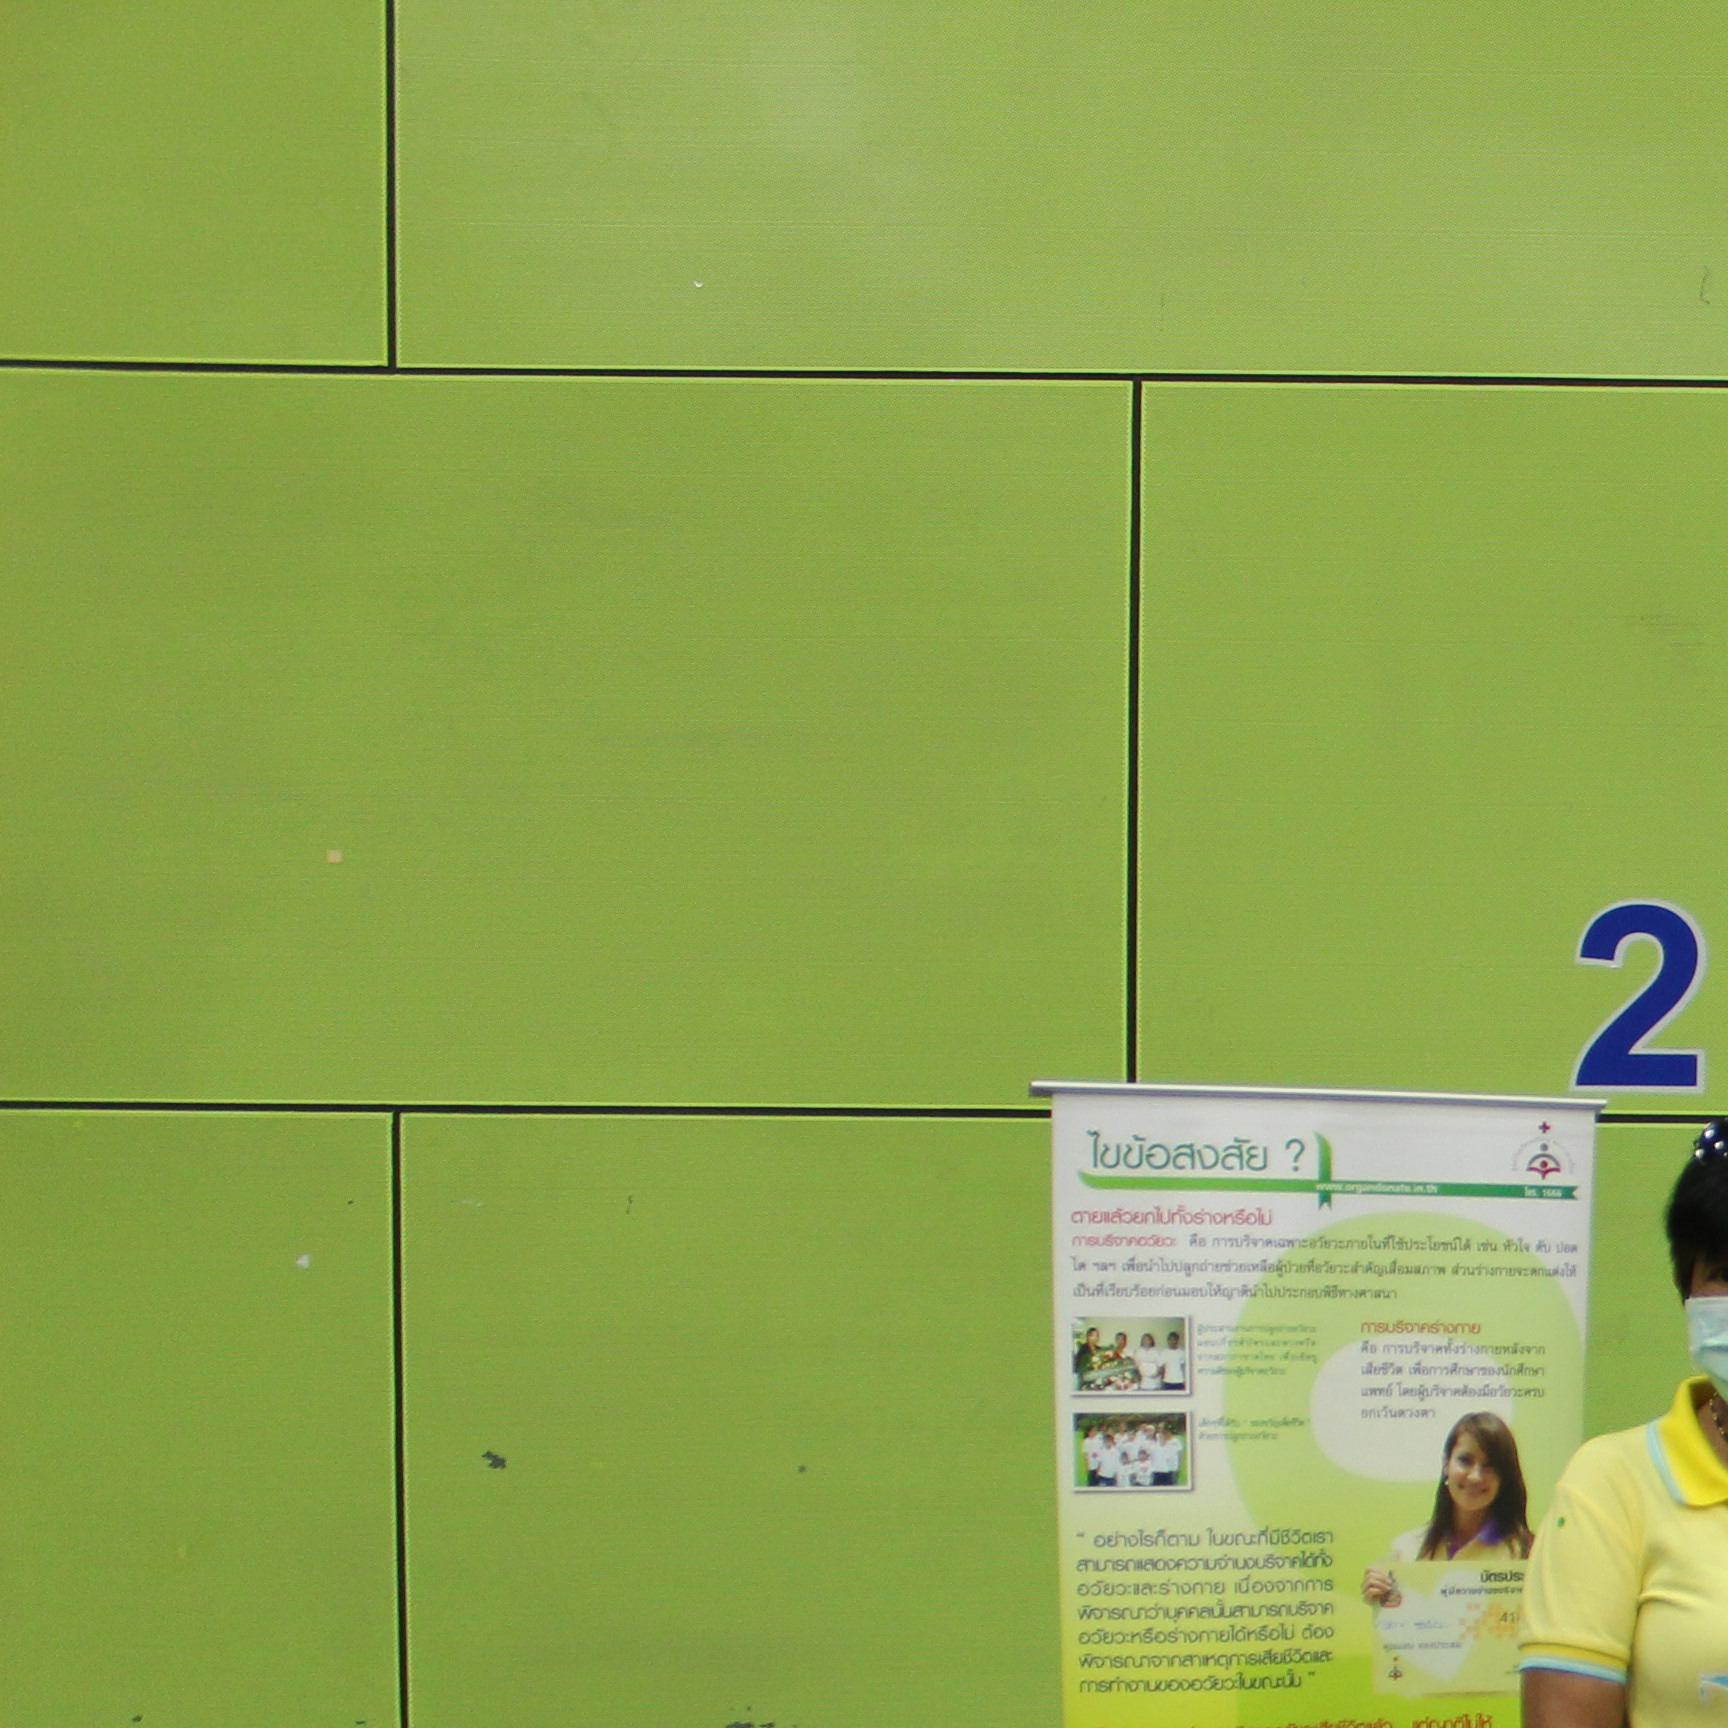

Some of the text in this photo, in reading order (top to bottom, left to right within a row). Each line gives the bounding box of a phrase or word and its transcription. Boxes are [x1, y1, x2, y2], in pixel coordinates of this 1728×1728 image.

[1569, 897, 1707, 1094] 2
[1086, 1129, 1306, 1172] ไขข้อสงสัย ?
[1071, 1204, 1273, 1226] ตายแล้วยกไปทั้งร่างหรือไม่
[1072, 1234, 1176, 1248] การบริจาคอวัยวะ
[1189, 1234, 1207, 1248] คือ
[1360, 1319, 1481, 1335] การบริจาคร่างกาย
[1361, 1339, 1377, 1355] คือ
[1093, 1528, 1200, 1548] อย่างไรก็ตาม
[1206, 1527, 1334, 1548] ในขณะที่มีชีวิตเรา
[1077, 1575, 1334, 1597] อวัยวะและร่างกาย เนื่องจากการ
[1078, 1623, 1335, 1645] อวัยวะหรือร่างกายได้หรือไม่ ต้อง
